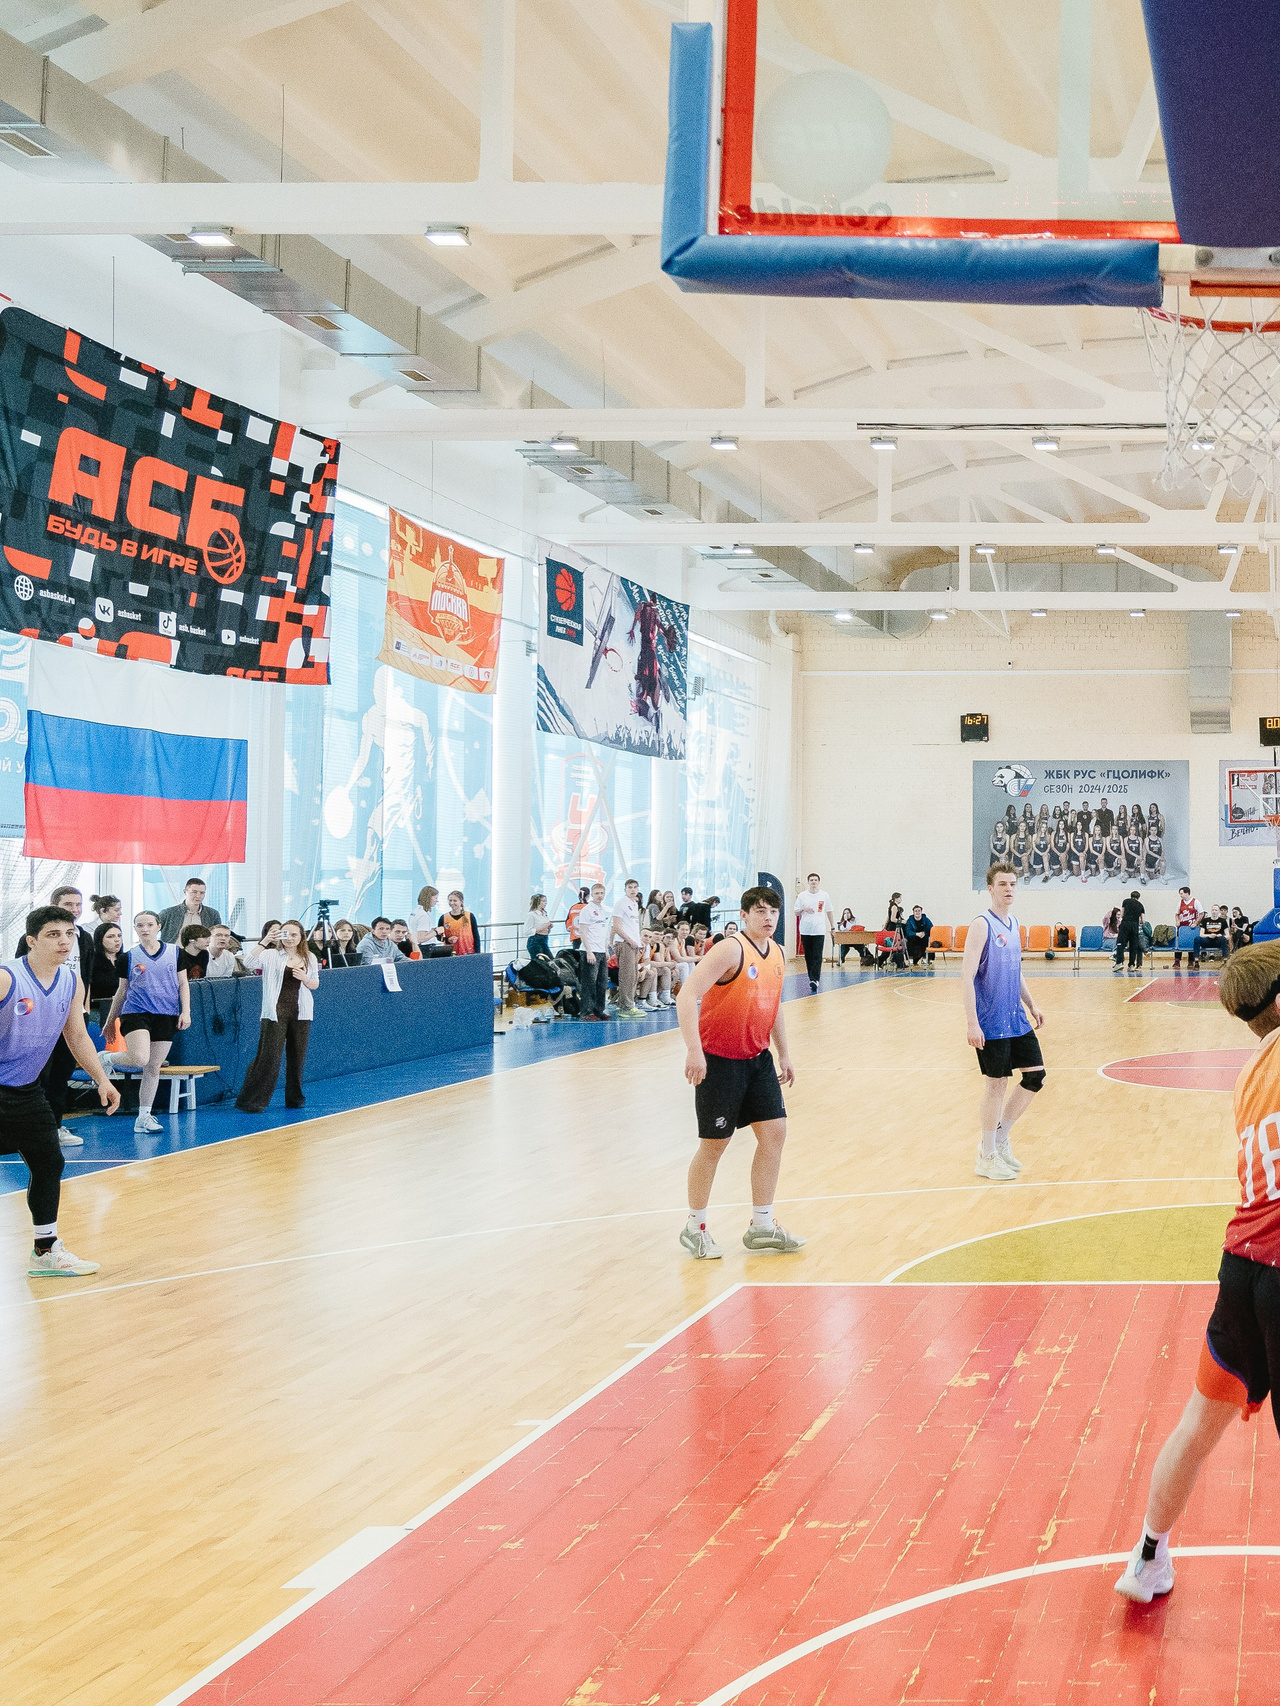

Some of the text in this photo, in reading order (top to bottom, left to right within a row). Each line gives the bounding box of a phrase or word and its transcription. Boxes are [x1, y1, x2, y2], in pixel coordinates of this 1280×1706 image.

[48, 426, 246, 552] АСБ
[46, 514, 199, 575] БУДЬ В ИГРЕ
[39, 588, 75, 605] asbasket.ru
[964, 715, 988, 725] 16:27
[1044, 769, 1171, 781] ЖБК РУС «ГЦОЛИФК»
[1043, 783, 1129, 794] СЕЗОН 2024/2025
